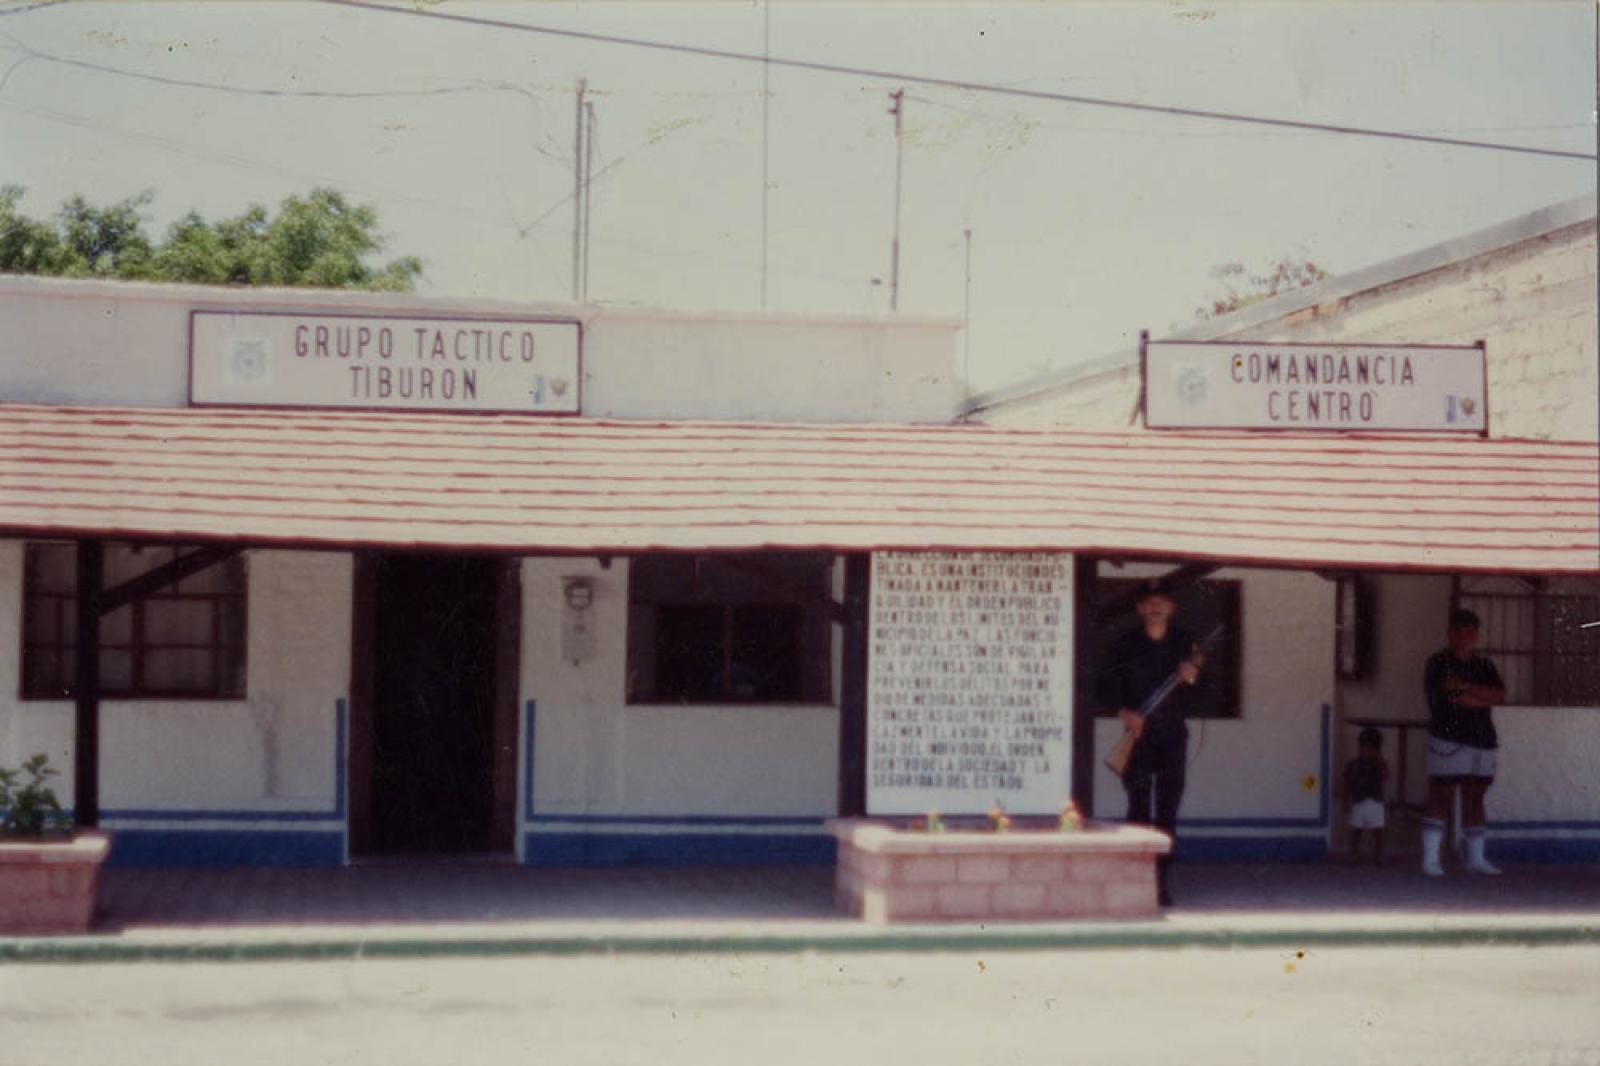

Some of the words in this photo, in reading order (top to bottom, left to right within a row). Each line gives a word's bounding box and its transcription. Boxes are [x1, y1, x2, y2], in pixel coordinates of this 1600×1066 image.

[294, 324, 393, 358] GRUPO
[414, 328, 535, 363] TACTICO
[349, 366, 478, 400] TIBURON
[1231, 352, 1415, 385] COMANDANCIA
[1267, 391, 1373, 422] CENTRO
